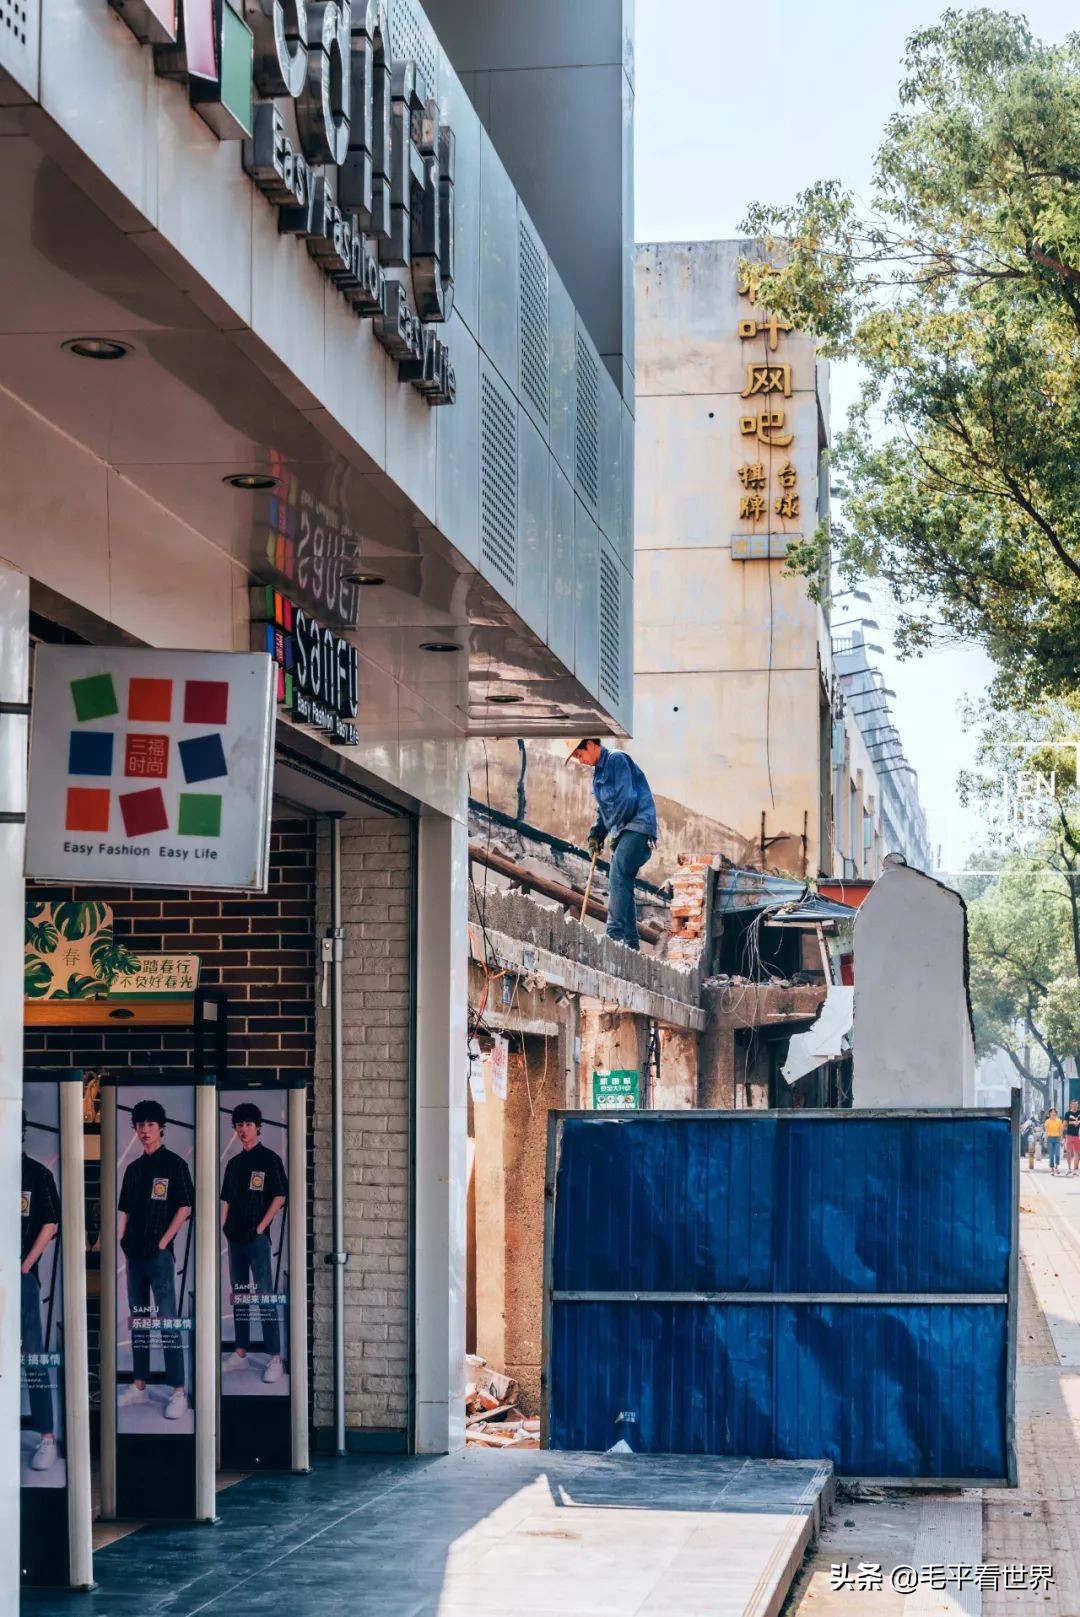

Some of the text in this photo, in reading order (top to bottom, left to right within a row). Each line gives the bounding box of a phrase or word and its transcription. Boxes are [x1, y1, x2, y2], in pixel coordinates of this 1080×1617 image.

[737, 267, 794, 447] 叶网吧
[129, 738, 165, 757] 三福
[128, 756, 164, 774] 时尚
[63, 841, 218, 861] Easy Fashion Easy Life
[63, 948, 81, 967] 春
[142, 959, 192, 975] 踏春行
[132, 1305, 160, 1313] SANFU
[132, 1318, 161, 1329] 乐起来
